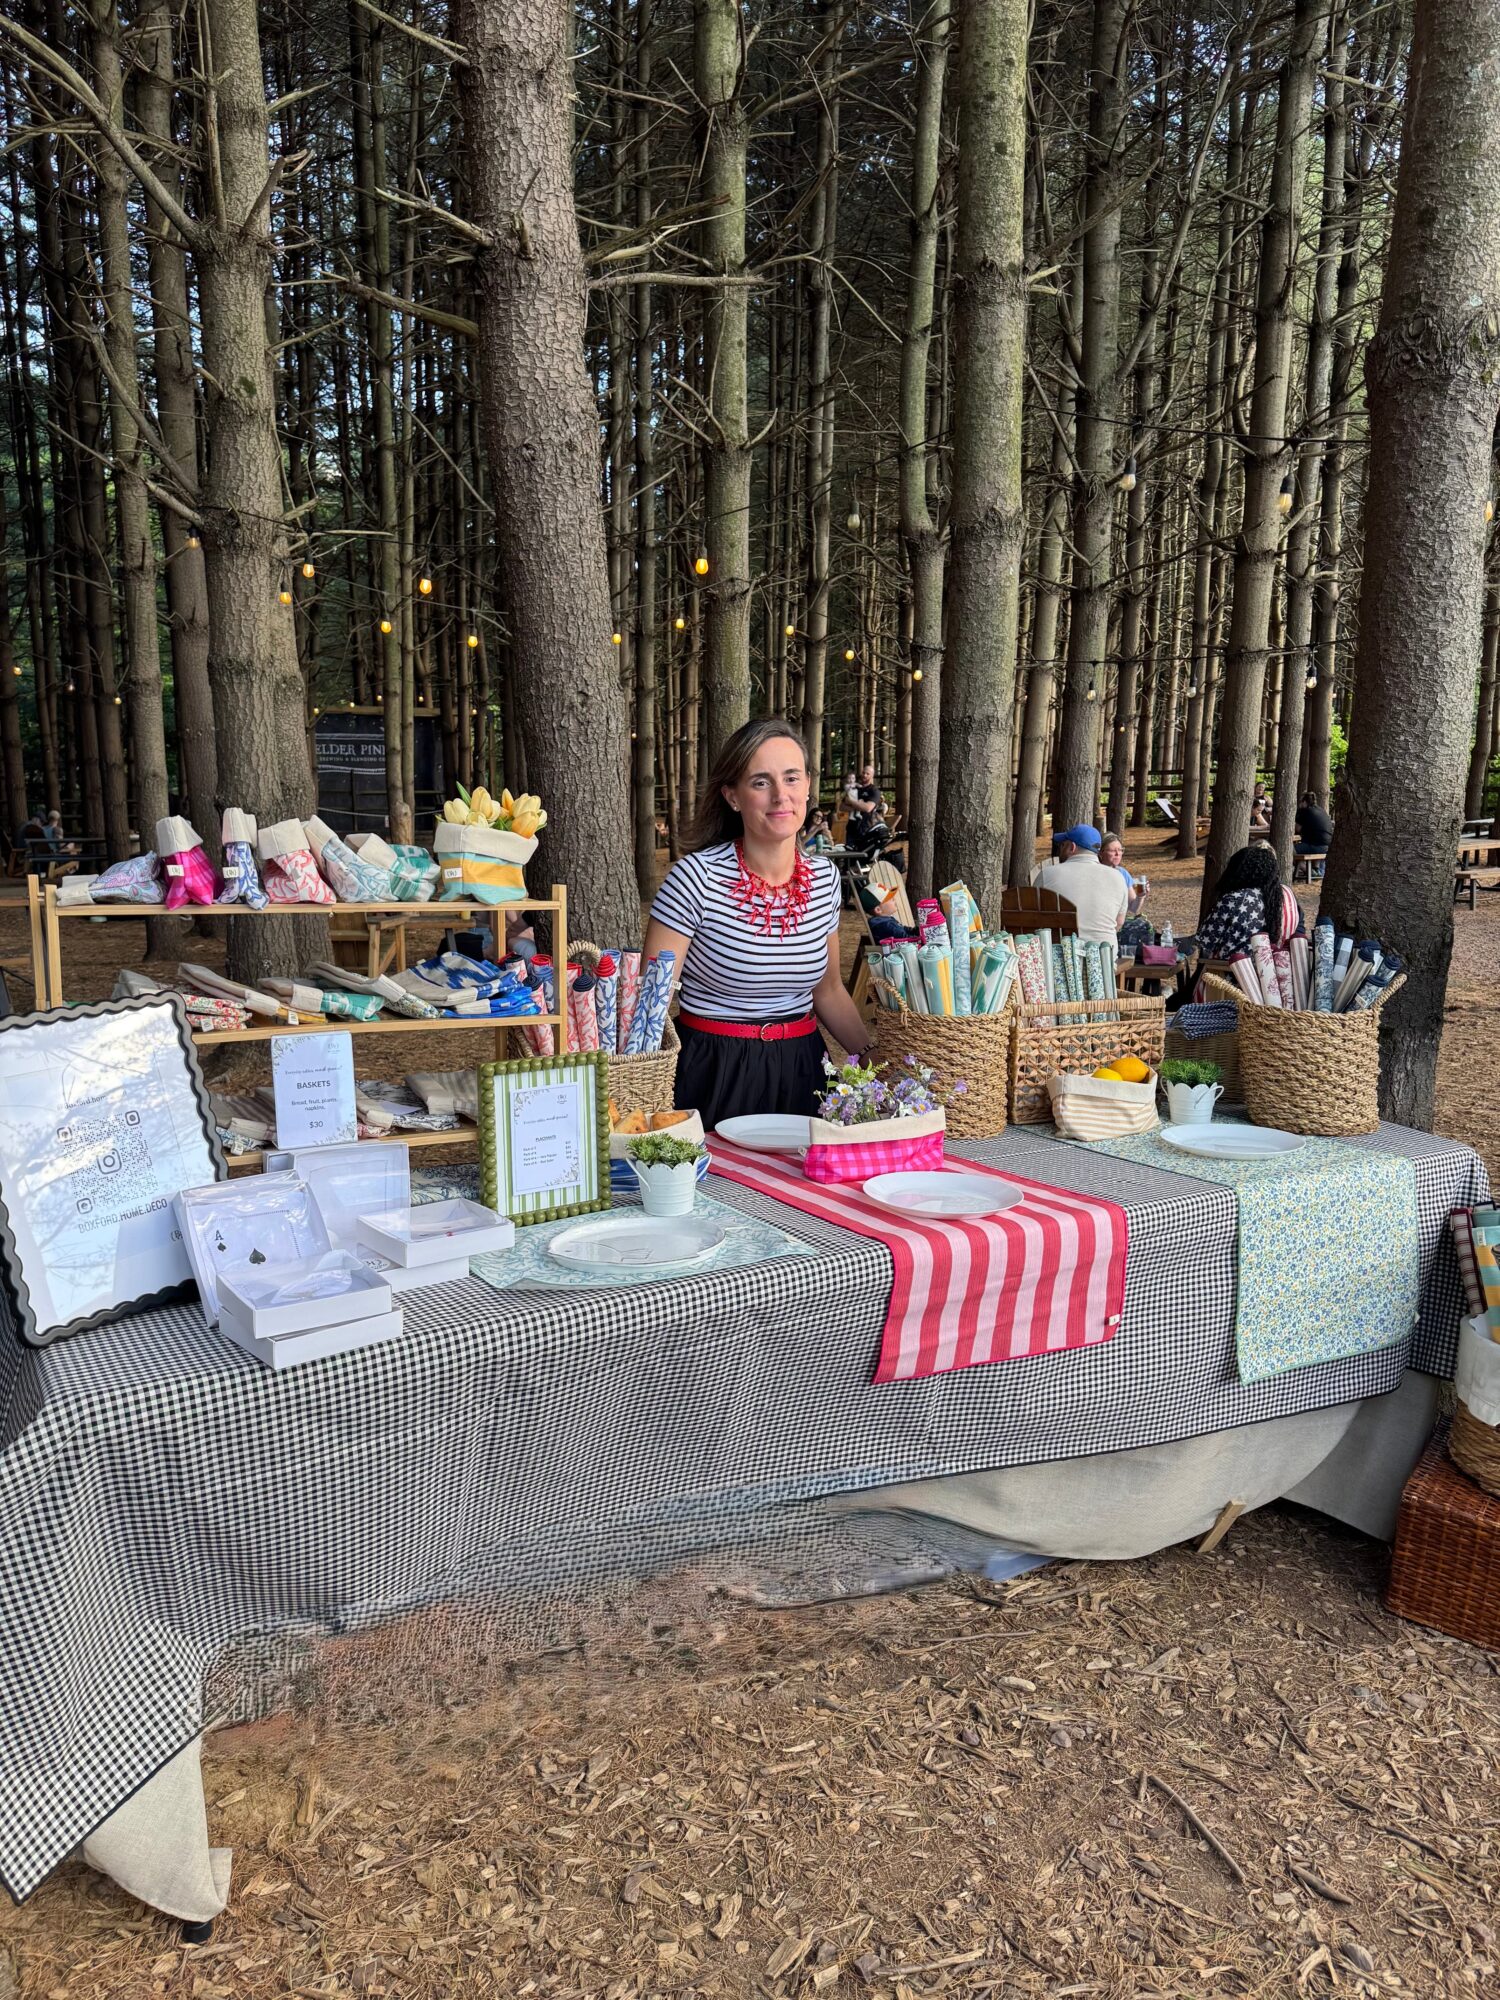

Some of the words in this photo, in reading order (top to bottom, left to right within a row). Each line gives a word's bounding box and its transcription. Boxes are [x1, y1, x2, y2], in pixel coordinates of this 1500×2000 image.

[315, 744, 356, 756] ELDER
[297, 1080, 331, 1089] BASKETS
[309, 1120, 323, 1128] $30
[78, 1198, 168, 1234] BOXFORD.HOME.DECO
[214, 1229, 224, 1241] A
